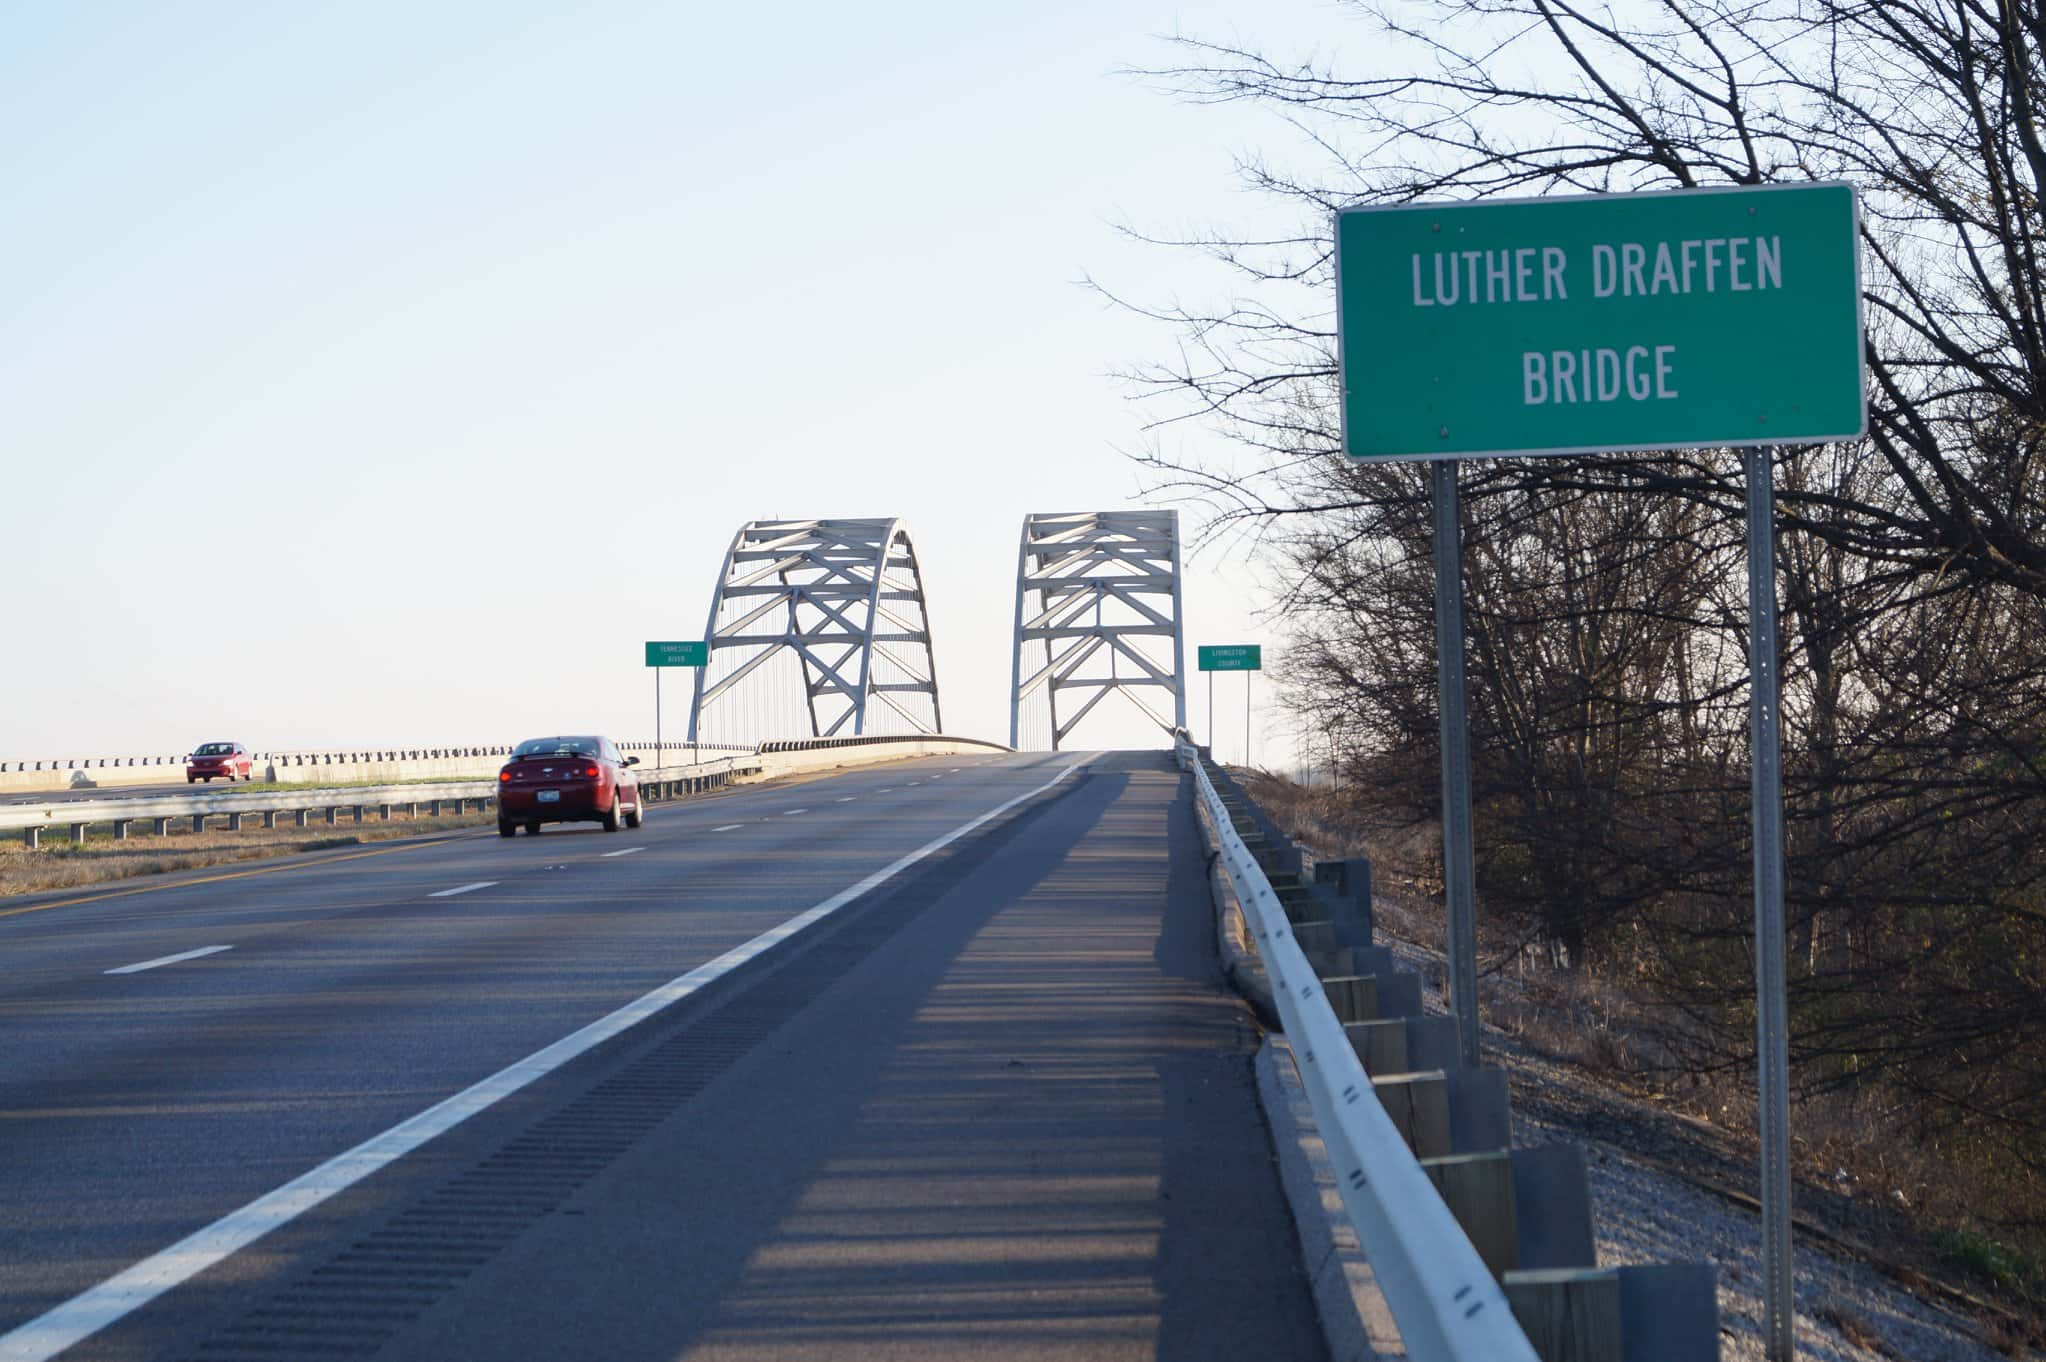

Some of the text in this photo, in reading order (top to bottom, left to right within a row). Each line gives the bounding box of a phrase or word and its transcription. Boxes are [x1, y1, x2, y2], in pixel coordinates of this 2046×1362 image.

[1412, 236, 1782, 306] LUTHER DRAFFEN
[1523, 345, 1678, 404] BRIDGE
